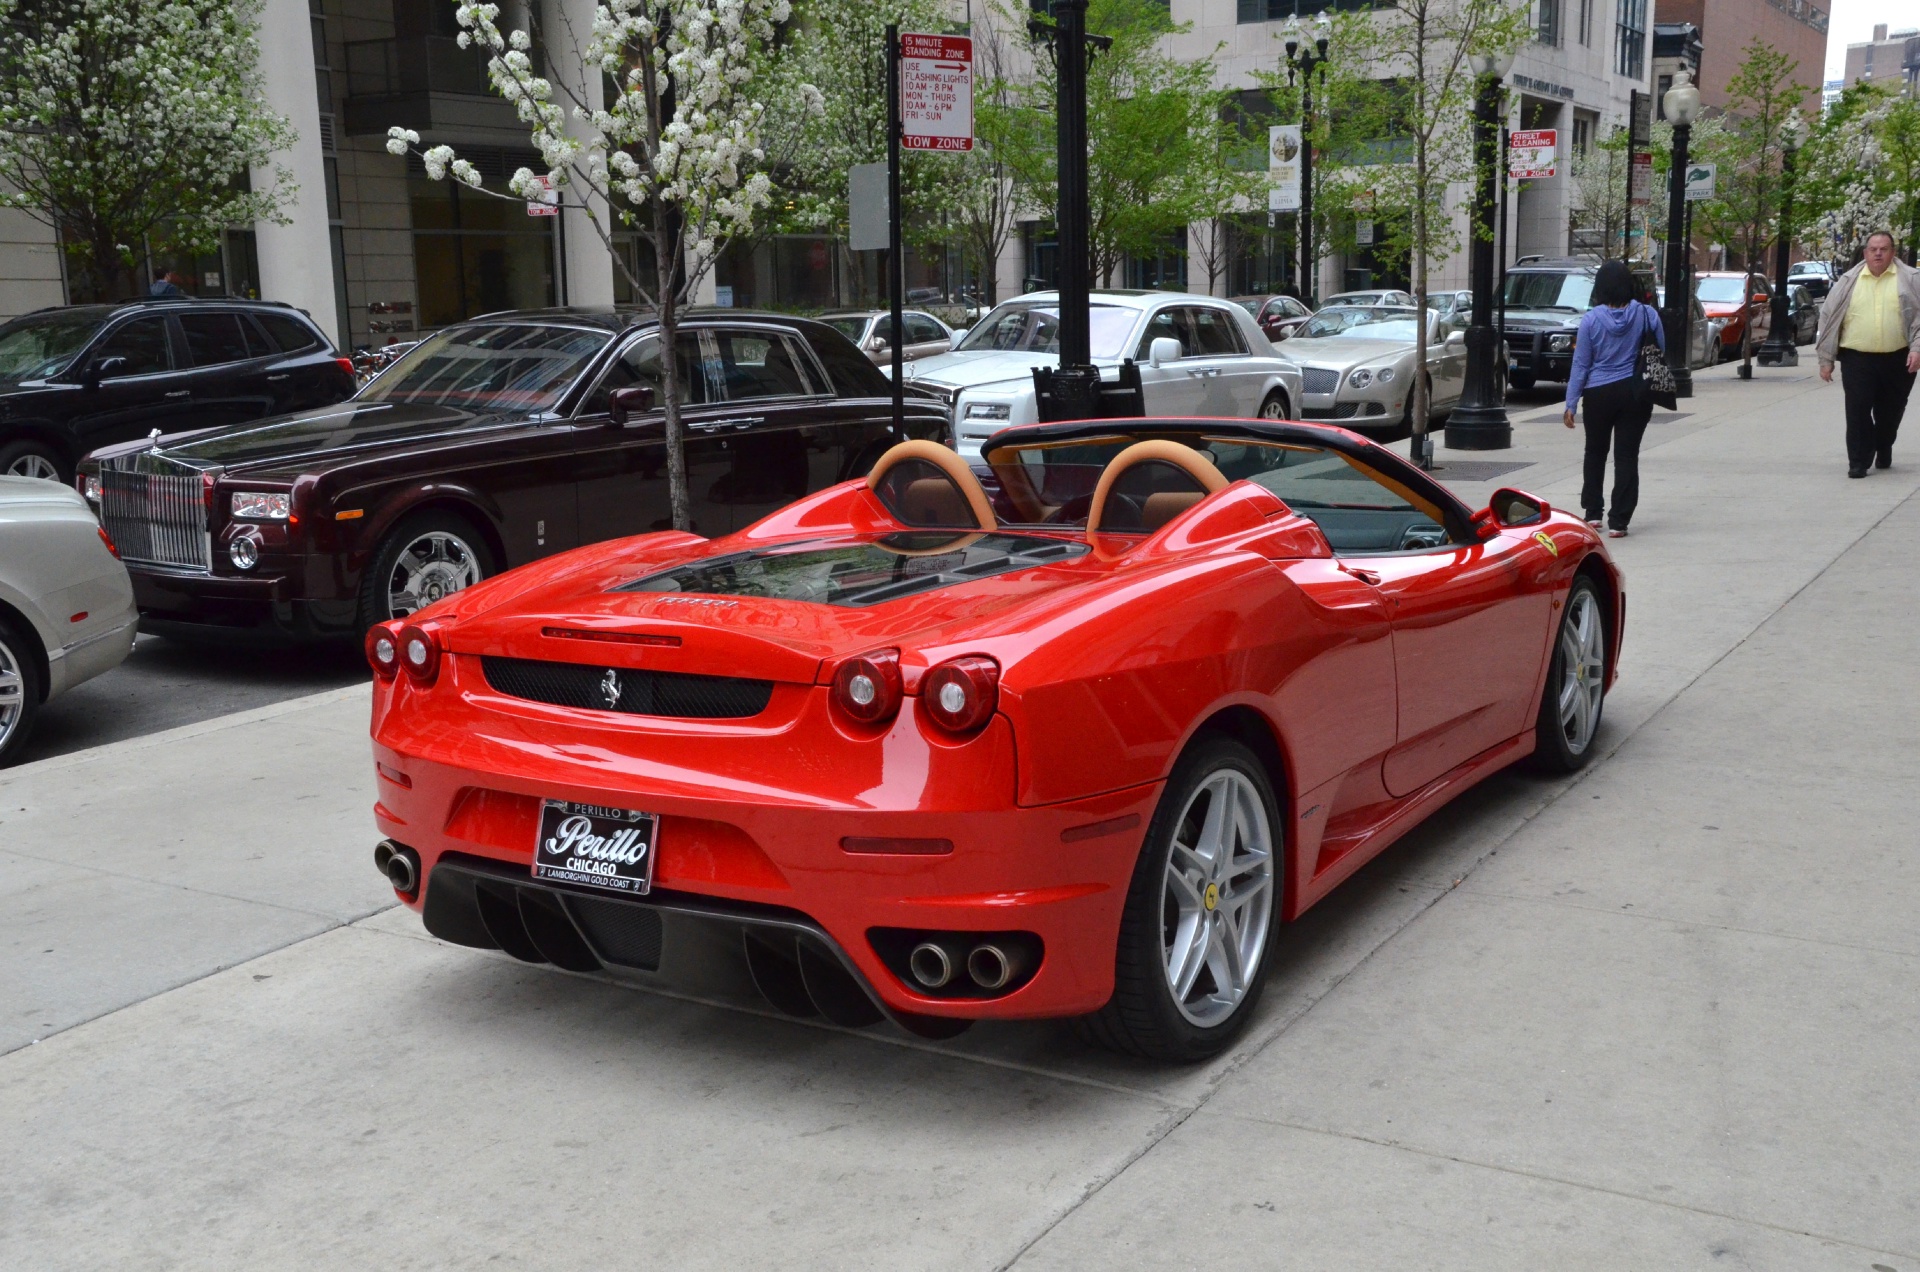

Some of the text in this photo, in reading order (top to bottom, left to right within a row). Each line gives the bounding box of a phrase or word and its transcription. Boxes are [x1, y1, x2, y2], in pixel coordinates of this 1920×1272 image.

[905, 37, 943, 48] 15 MINUTE
[906, 47, 965, 59] STANDING ZONE
[906, 63, 920, 71] USE
[906, 73, 969, 84] FLASHING LIGHTS
[906, 82, 914, 90] 10
[915, 83, 927, 91] AM
[942, 84, 953, 92] PM
[906, 92, 923, 100] MON
[932, 93, 957, 102] THURS
[906, 102, 914, 110] 10
[915, 102, 926, 110] AM
[935, 103, 940, 111] 6
[941, 104, 952, 112] PM
[906, 111, 918, 119] FRI
[926, 112, 942, 120] SUN
[907, 136, 967, 150] TOW ZONE
[1514, 139, 1551, 147] CLEANING
[1531, 169, 1551, 177] ZONE
[575, 804, 621, 819] PERILLO
[545, 815, 647, 865] Perillo
[566, 858, 617, 876] CHICAGO
[548, 869, 630, 889] LAMBORGHINI GOLD COAST
